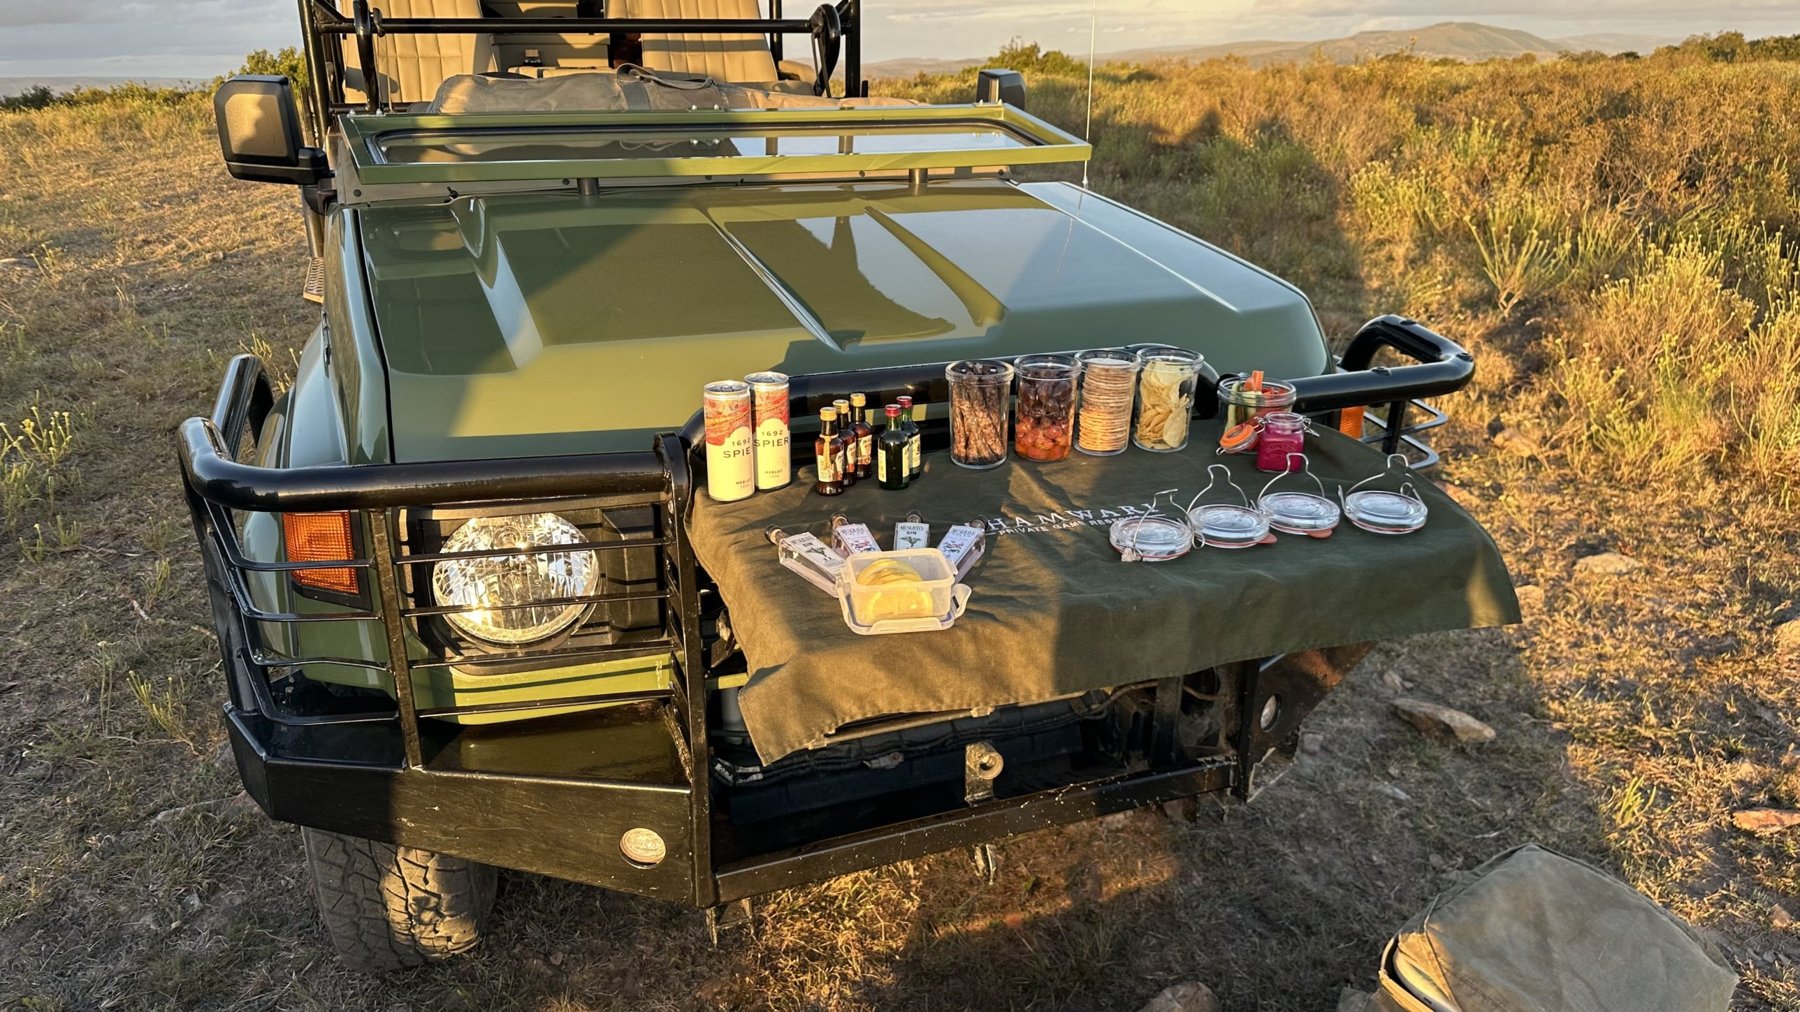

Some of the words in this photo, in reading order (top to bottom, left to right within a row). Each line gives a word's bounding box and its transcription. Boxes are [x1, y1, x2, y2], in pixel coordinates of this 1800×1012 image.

[754, 436, 789, 447] SPIER
[723, 446, 751, 459] SPIE
[987, 503, 1159, 530] HAMWARI
[998, 525, 1049, 536] PRIVATE
[1052, 520, 1086, 529] GAME
